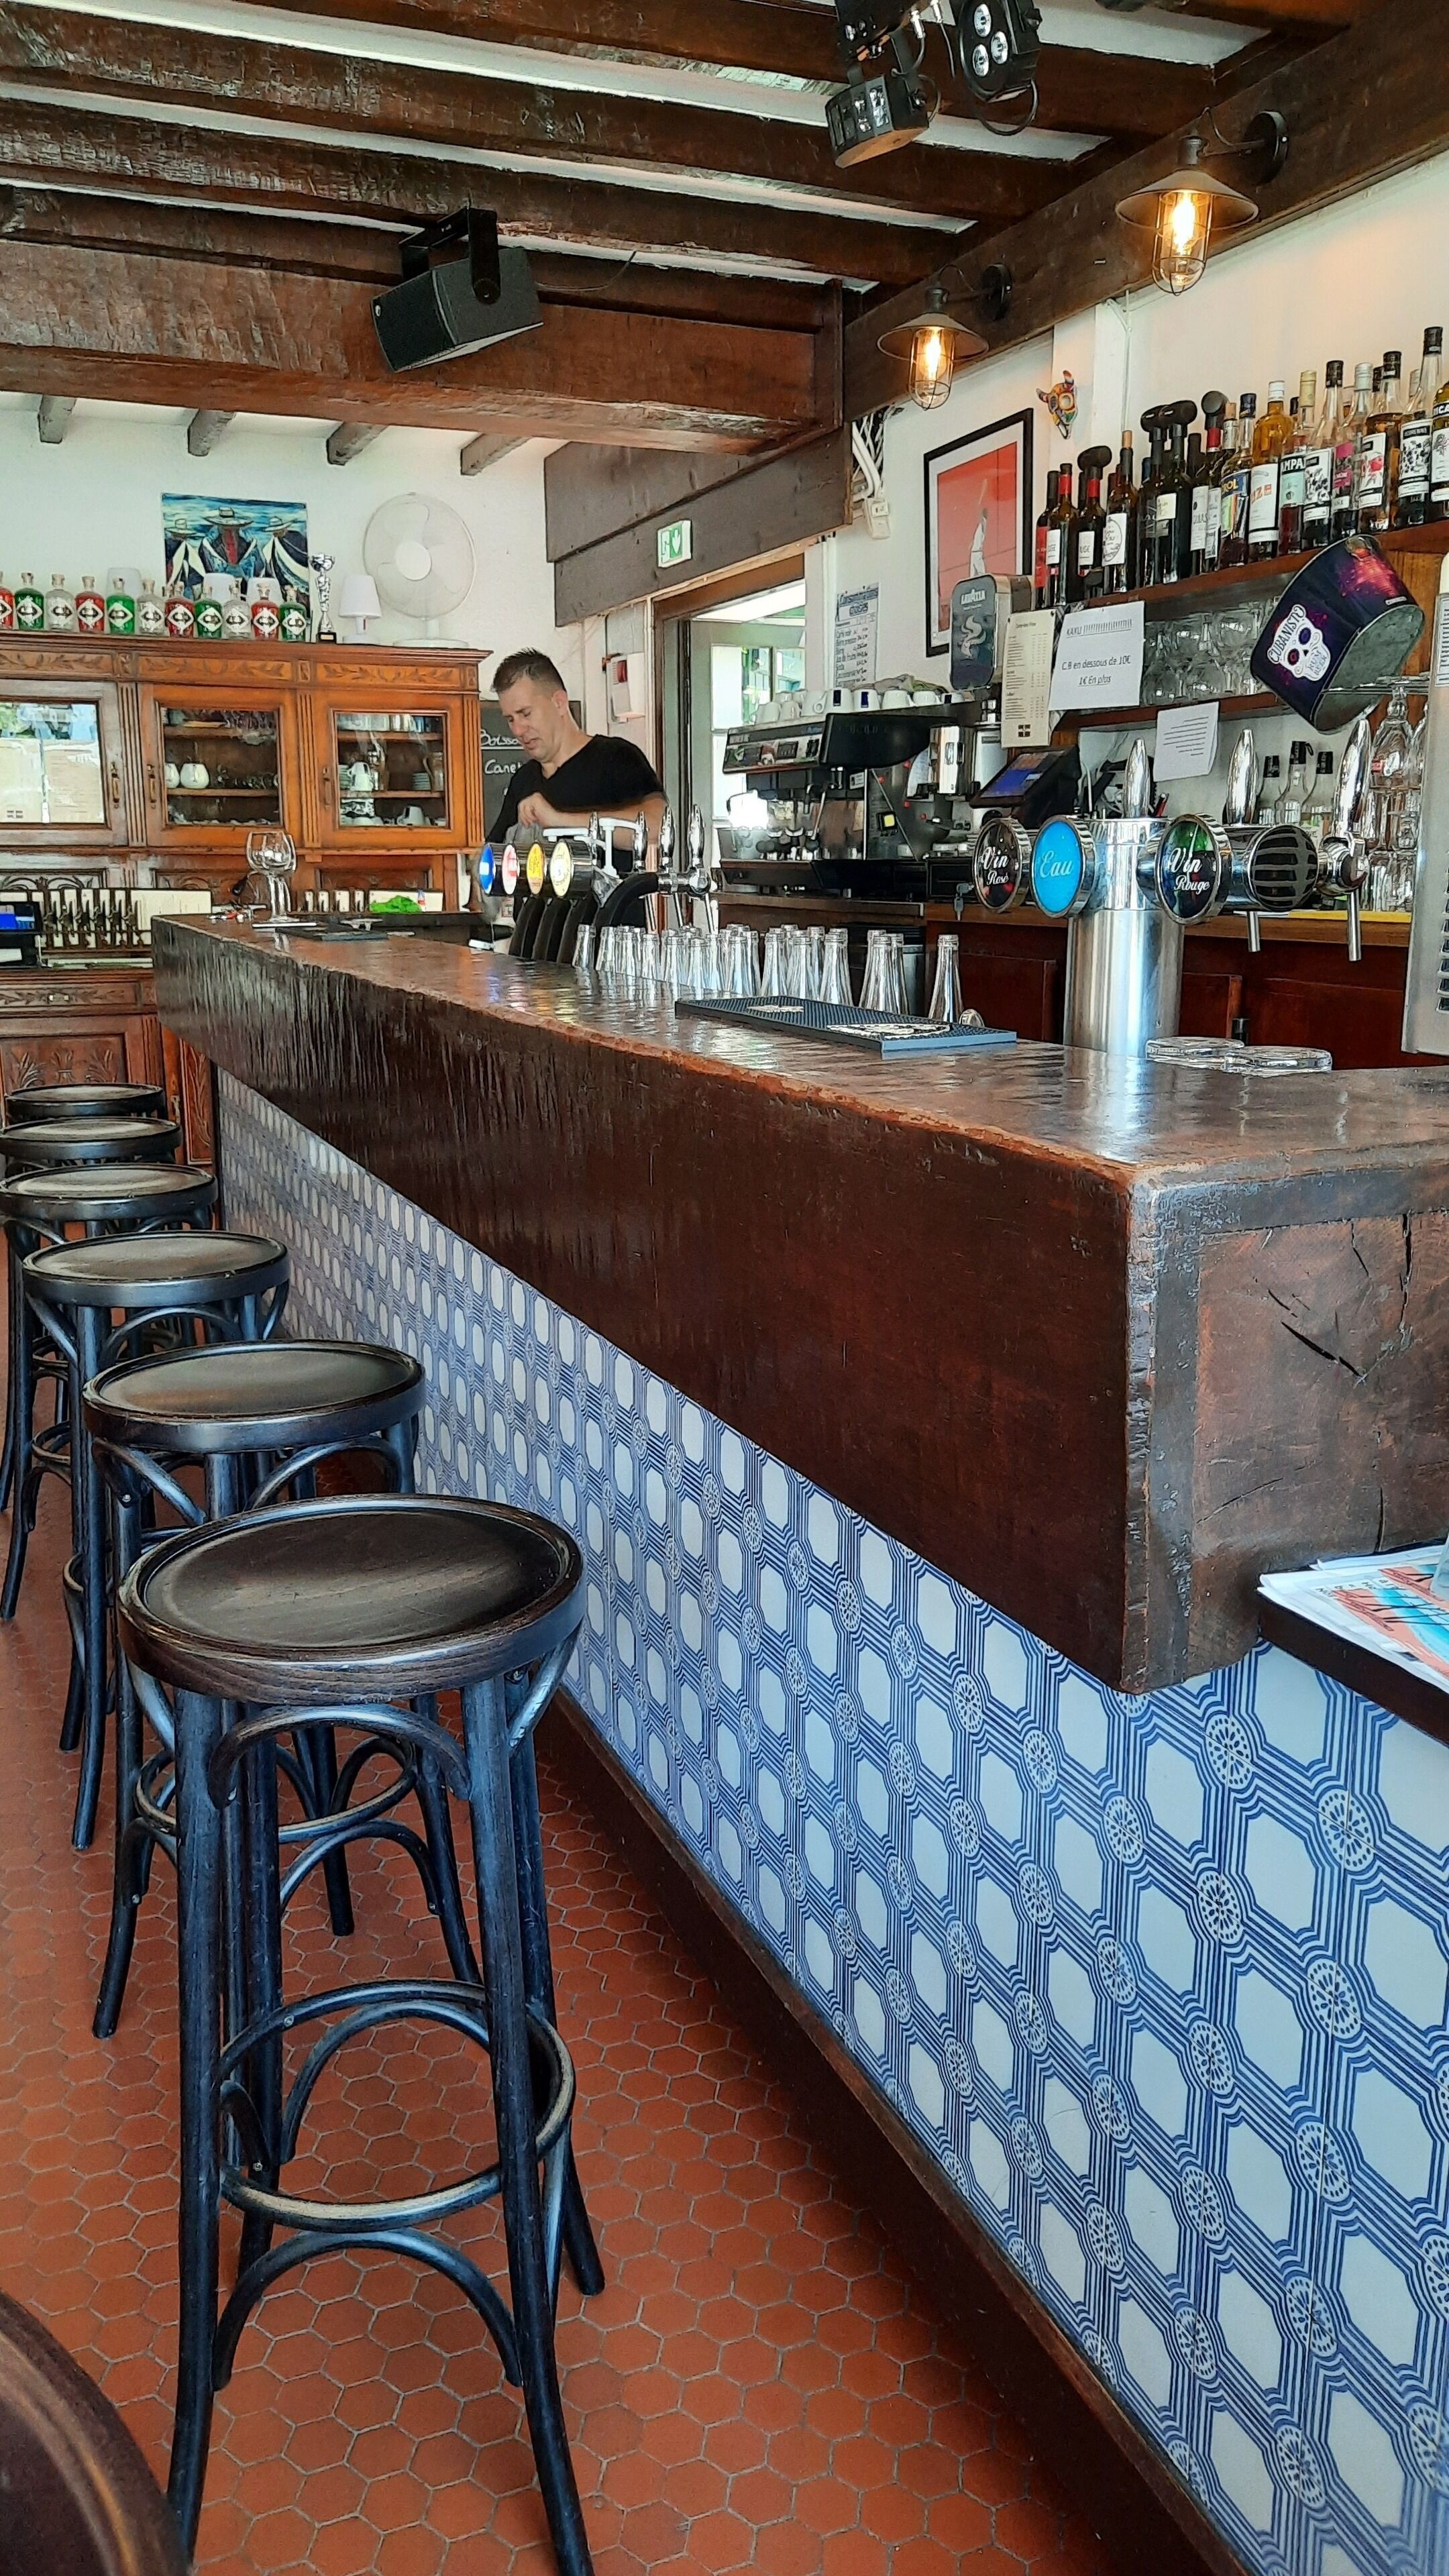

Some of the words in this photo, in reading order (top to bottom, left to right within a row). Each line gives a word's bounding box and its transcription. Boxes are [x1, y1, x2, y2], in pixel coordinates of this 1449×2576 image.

[1268, 605, 1305, 663] CUBANISTO
[1082, 659, 1107, 668] dessous
[1109, 657, 1117, 665] de
[1097, 674, 1112, 684] plus
[480, 729, 522, 746] Boisso
[981, 847, 1010, 870] Vin
[1040, 851, 1073, 879] Eau
[1168, 847, 1201, 873] Vin
[1175, 874, 1210, 892] Rouge
